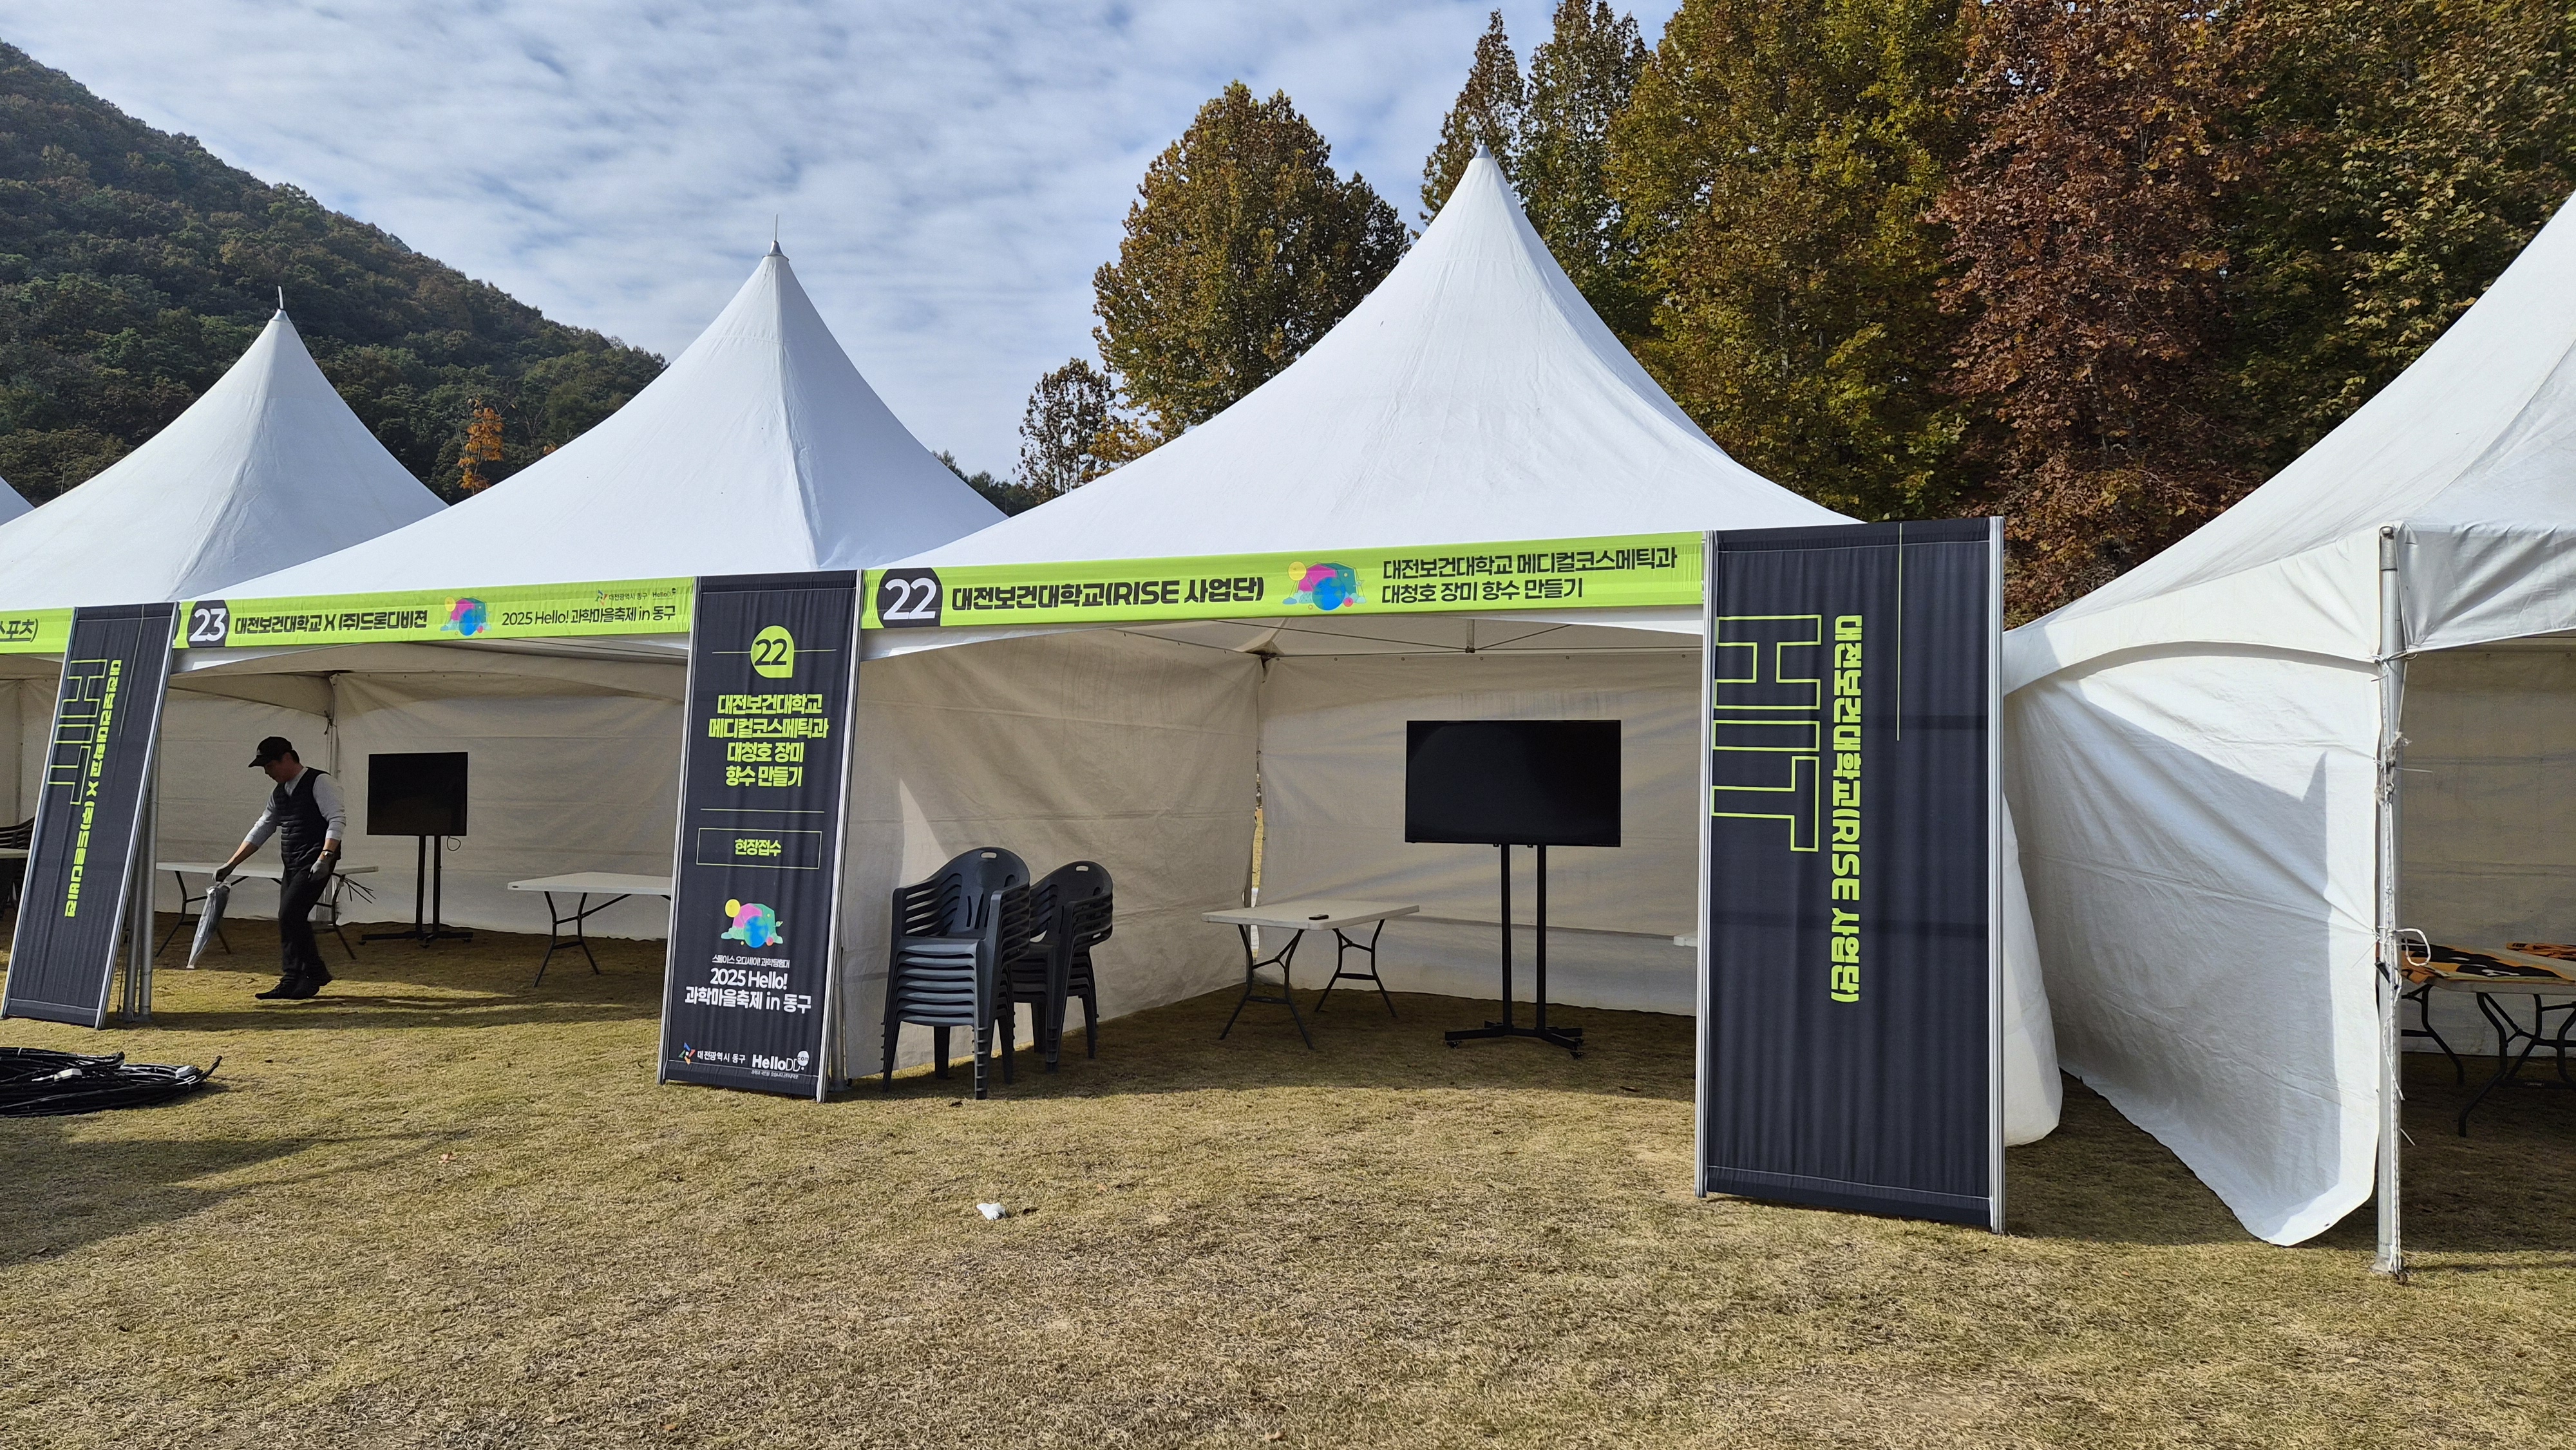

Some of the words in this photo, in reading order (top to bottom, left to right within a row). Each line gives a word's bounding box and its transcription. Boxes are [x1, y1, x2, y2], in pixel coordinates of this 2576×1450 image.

[1383, 556, 1513, 579] 대전보건대학교
[1517, 547, 1677, 574] 메디컬코스메틱과
[883, 578, 936, 619] 22
[952, 579, 1180, 610] 대전보건대학교(RISE
[1186, 577, 1264, 603] 사업단)
[1381, 580, 1437, 604] 대청호
[1441, 581, 1477, 602] 장미
[1481, 579, 1520, 601] 향수
[1524, 578, 1583, 599] 만들기
[189, 608, 226, 641] 23
[234, 614, 322, 634] 대전보건대학교
[323, 614, 337, 632] X
[502, 612, 533, 626] 2025
[535, 610, 568, 625] Hello!
[571, 607, 636, 623] 과학마을축제
[638, 605, 650, 620] in
[652, 605, 676, 621] 동구
[754, 638, 788, 666] 22
[717, 694, 822, 715] 대전보건대학교
[47, 659, 107, 805] HIT
[92, 659, 122, 778] 대전보건대학교
[708, 718, 829, 739] 메디컬코스메틱과
[1711, 614, 1823, 852] HIT
[727, 742, 772, 762] 대청호
[775, 742, 804, 762] 장미
[1831, 614, 1862, 902] 대전보건대학교(RISE
[86, 780, 99, 798] X
[726, 766, 755, 786] 향수
[757, 766, 803, 787] 만들기
[735, 838, 782, 856] 현장접수
[1830, 907, 1861, 1003] 사업단)
[710, 968, 746, 986] 2025
[748, 970, 788, 990] Hello!
[685, 986, 762, 1010] 과학마을축제
[766, 992, 780, 1011] in
[783, 994, 811, 1014] 동구
[697, 1050, 730, 1062] 대전광역시
[732, 1054, 746, 1064] 동구
